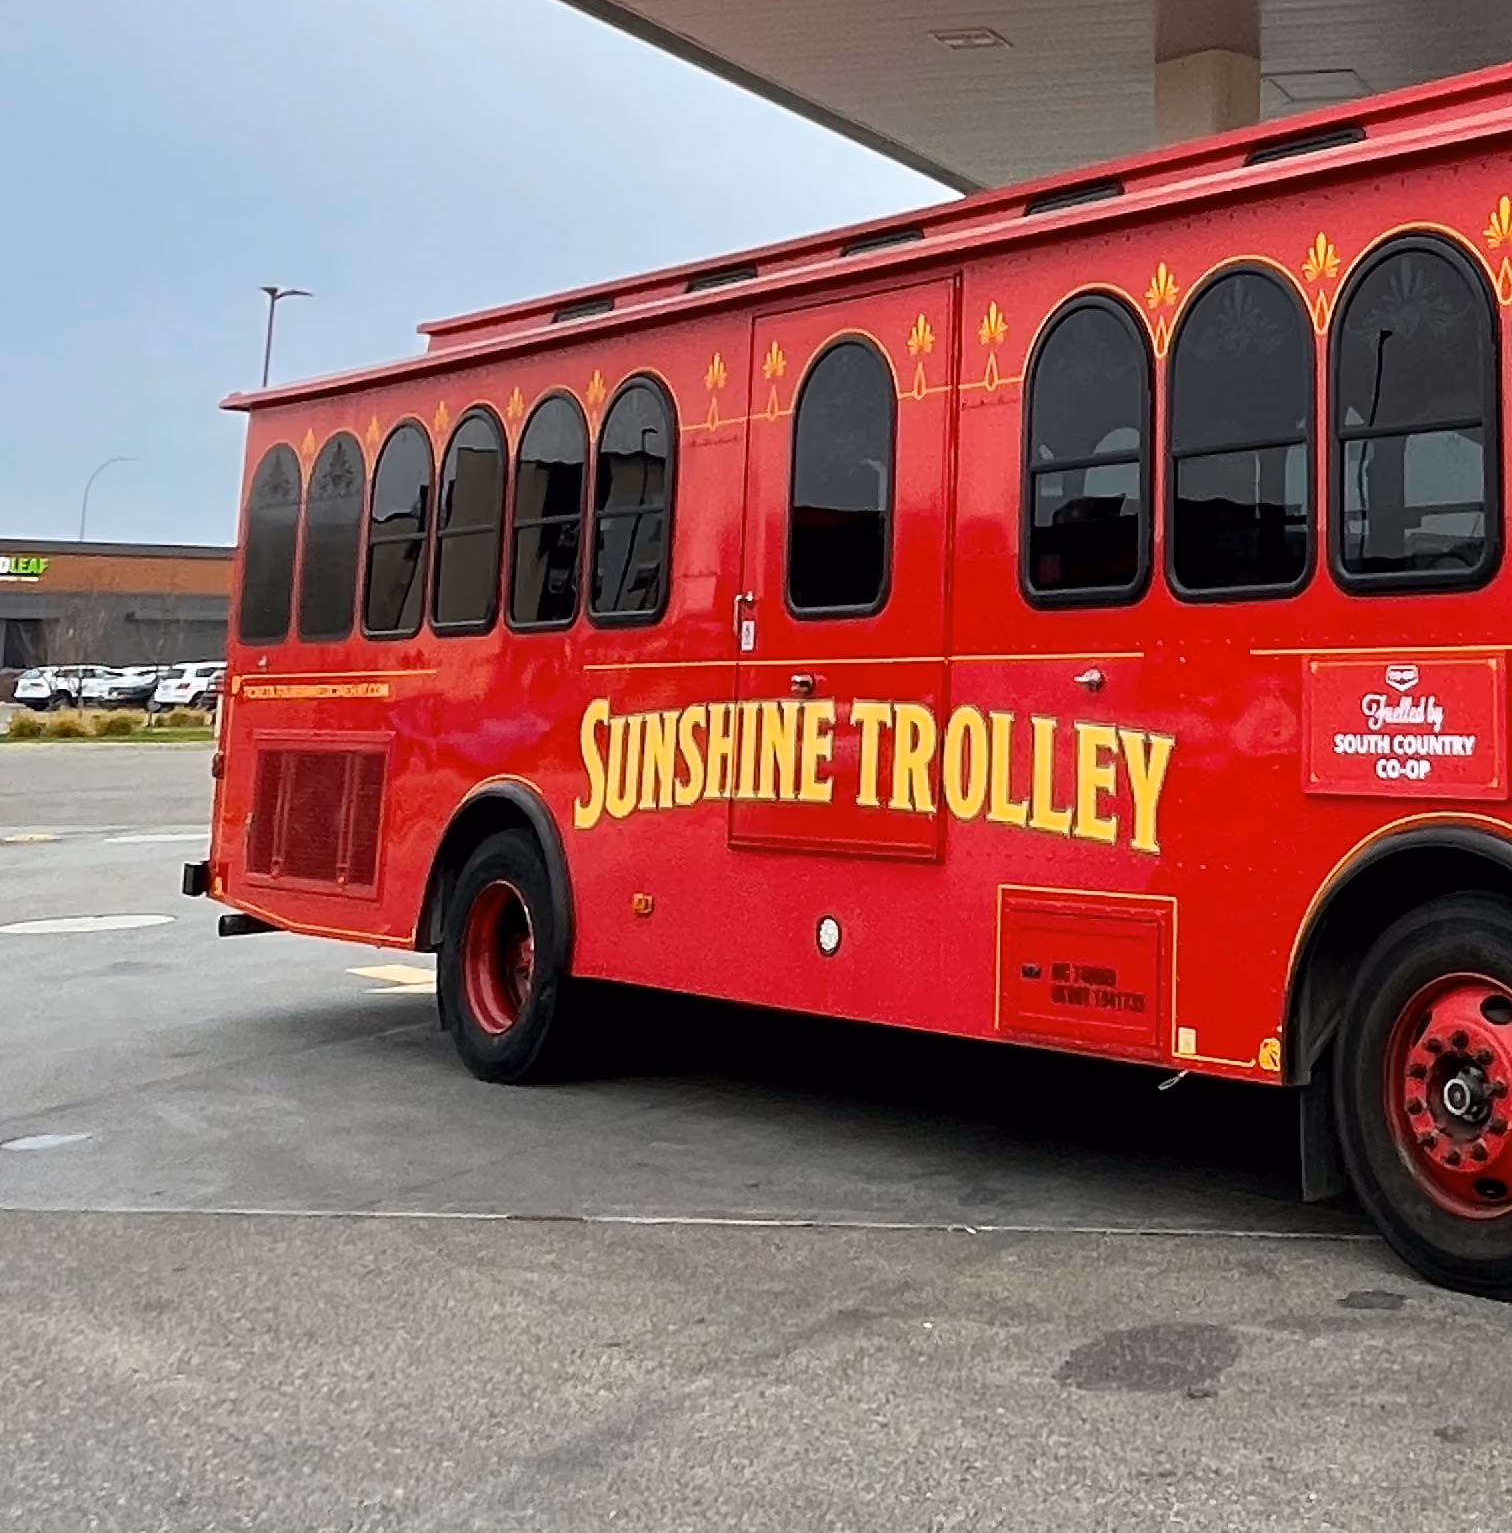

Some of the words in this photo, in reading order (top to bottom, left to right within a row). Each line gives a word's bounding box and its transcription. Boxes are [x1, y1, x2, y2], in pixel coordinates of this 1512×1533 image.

[1426, 695, 1444, 733] by
[1333, 733, 1390, 755] SOUTH
[1393, 734, 1476, 756] COUNTRY
[574, 698, 836, 831] SUNSHINE
[849, 698, 1176, 856] TROLLEY
[1376, 758, 1431, 780] CO-OP
